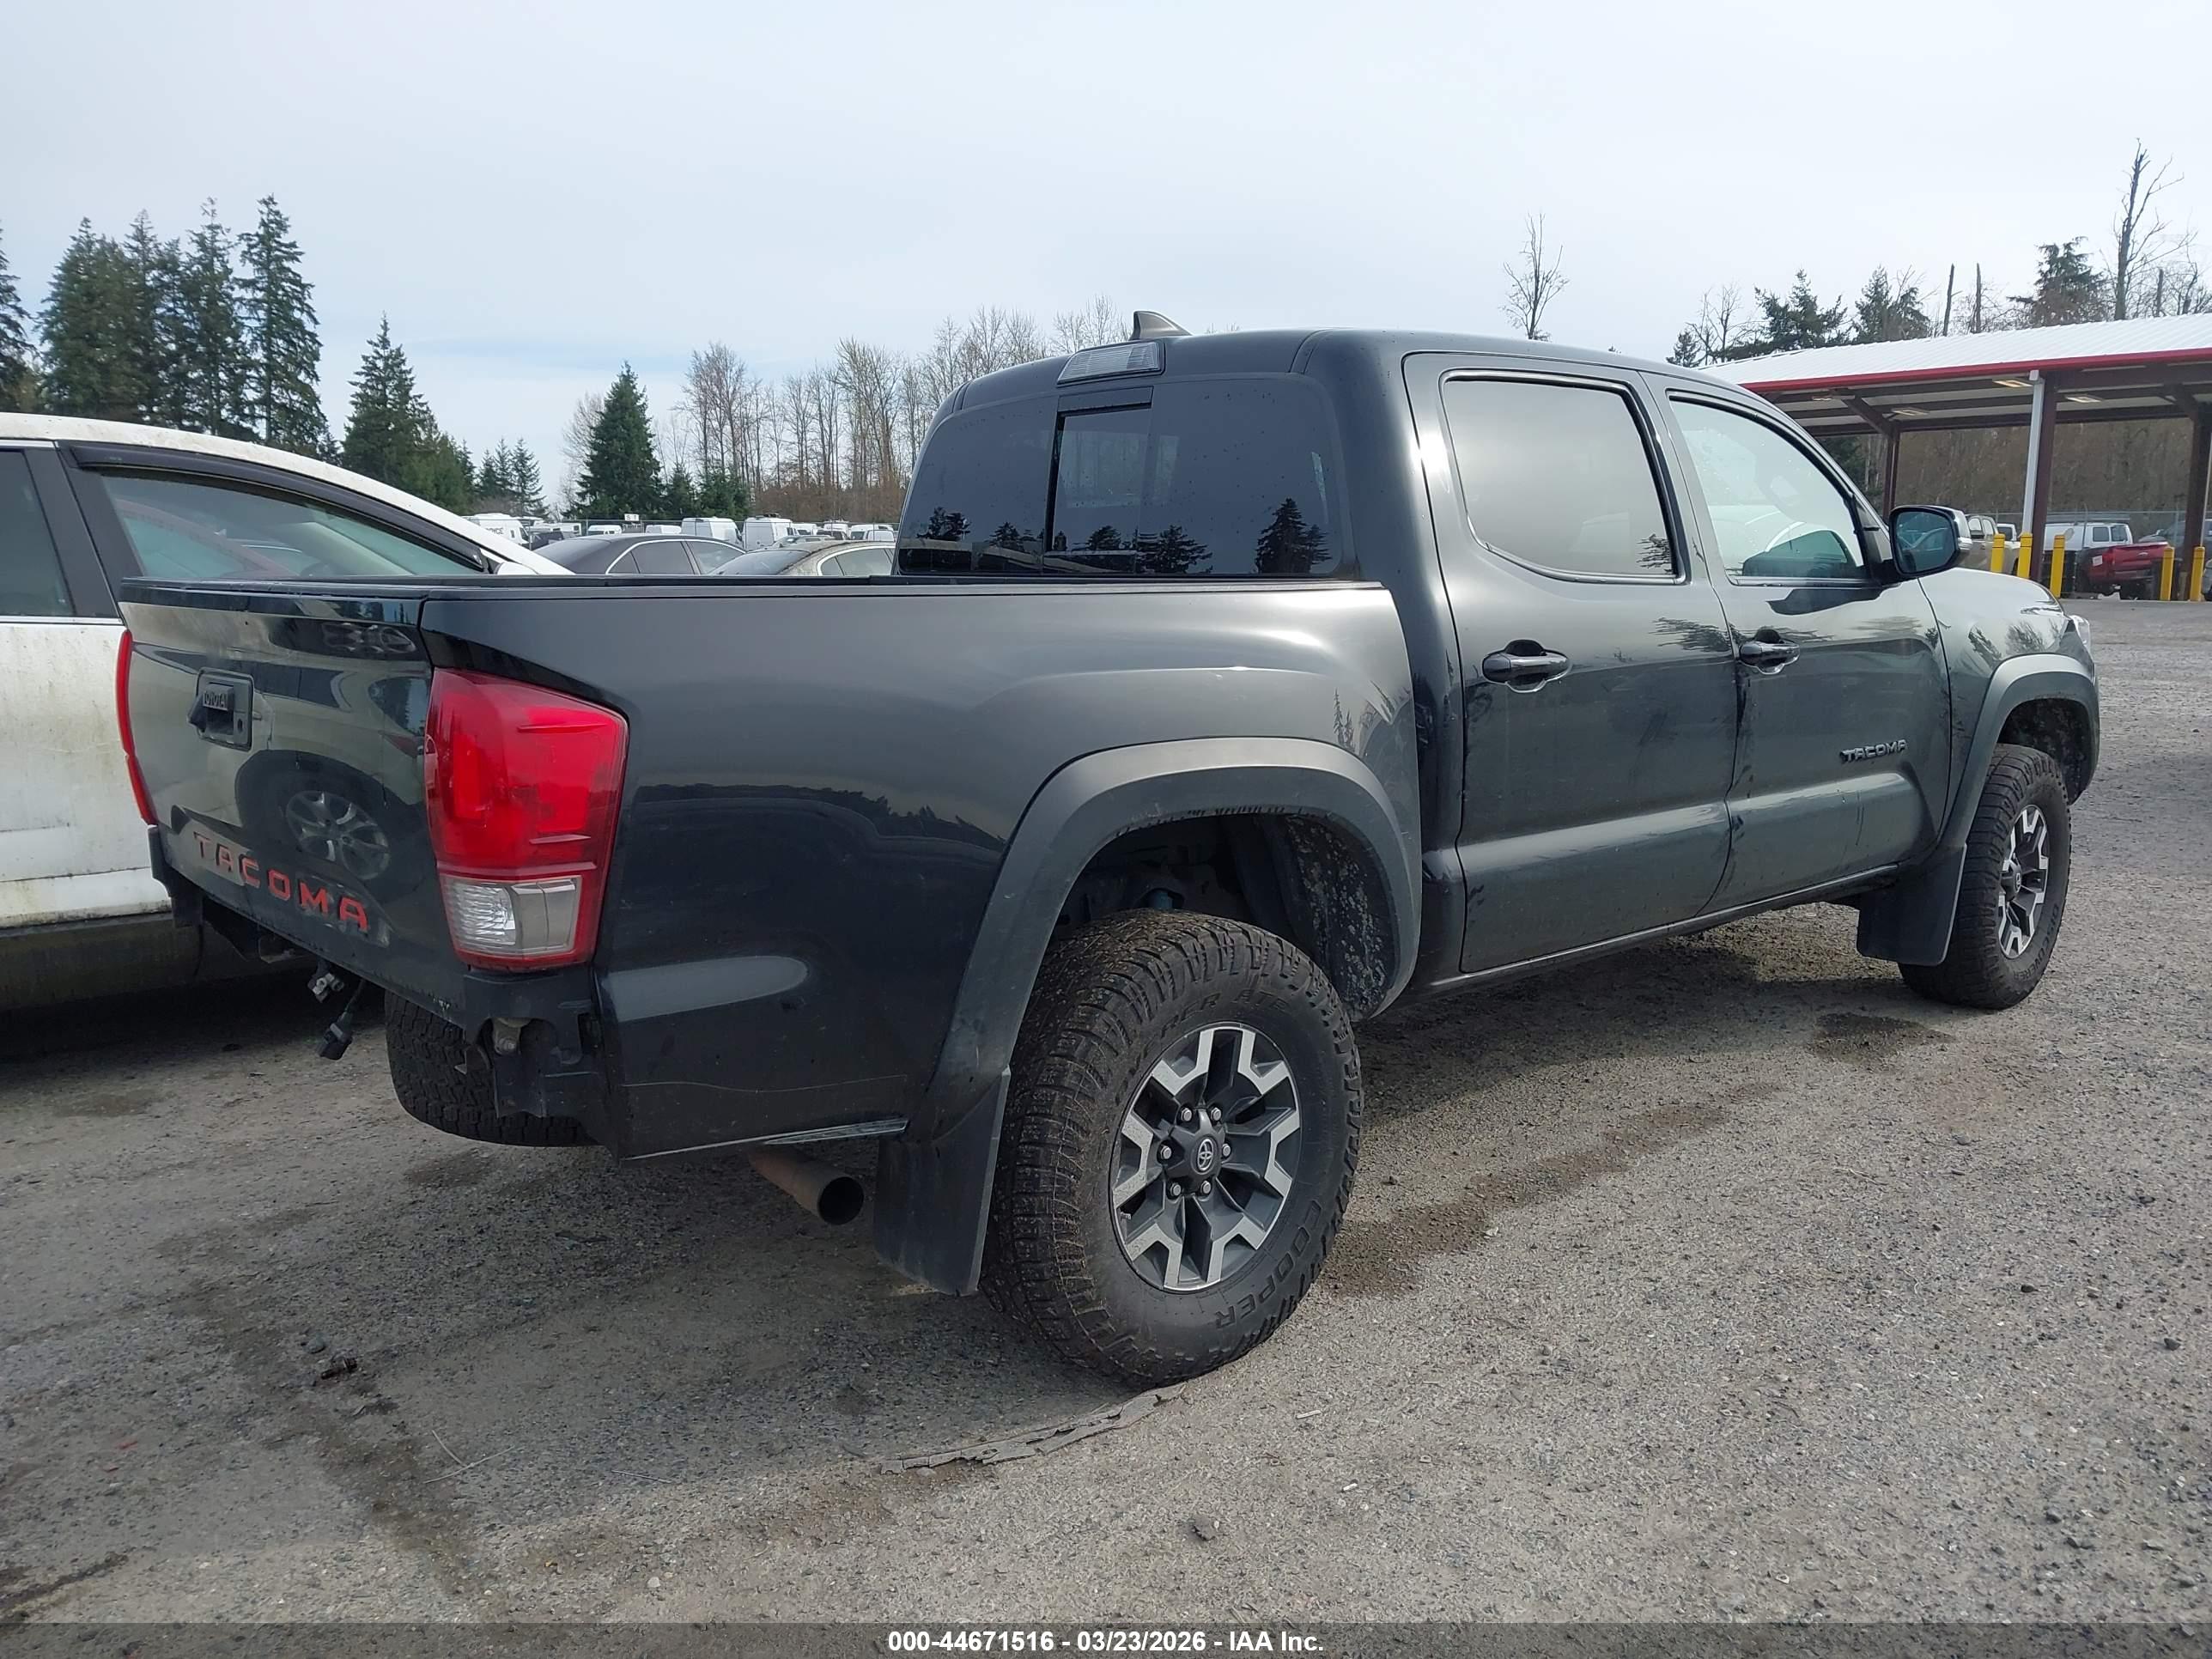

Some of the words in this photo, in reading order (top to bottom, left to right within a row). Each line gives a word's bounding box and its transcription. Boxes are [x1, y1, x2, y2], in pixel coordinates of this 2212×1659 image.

[1839, 738, 1908, 763] TACOMA
[193, 830, 369, 933] TACOMA
[1214, 1200, 1322, 1329] COOPER
